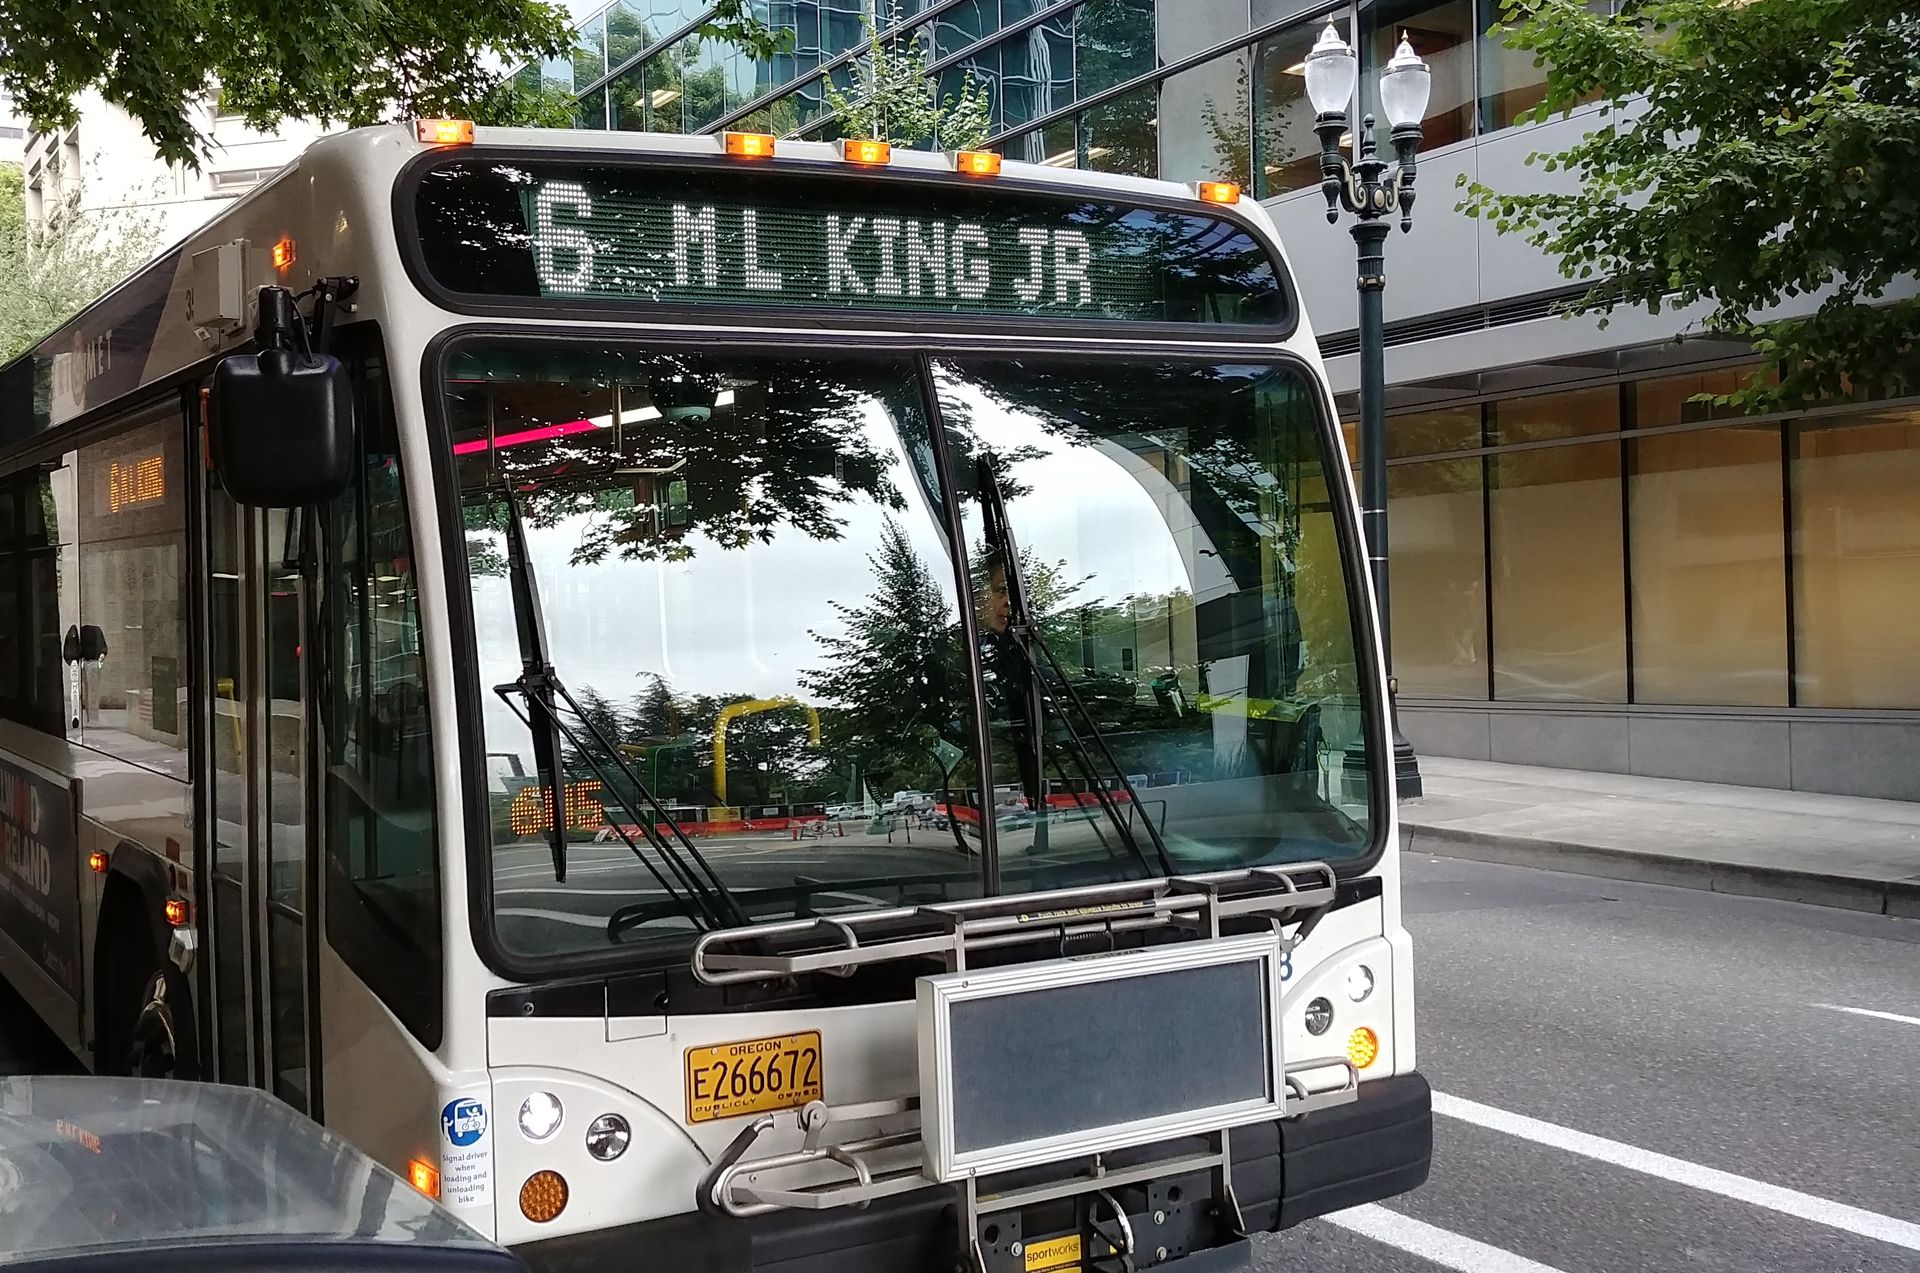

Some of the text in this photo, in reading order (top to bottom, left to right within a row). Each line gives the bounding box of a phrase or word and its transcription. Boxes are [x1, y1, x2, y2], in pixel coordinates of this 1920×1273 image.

[537, 182, 593, 293] 6
[827, 214, 990, 299] KING
[1014, 227, 1092, 303] JR
[730, 1040, 782, 1056] OREGON
[693, 1047, 818, 1102] E266672
[695, 1087, 819, 1113] PUBLICLY OWNED
[442, 1151, 488, 1164] Signal driver
[455, 1164, 476, 1172] when
[444, 1171, 487, 1183] loading and
[447, 1183, 485, 1194] unloading
[458, 1195, 475, 1204] bike
[1026, 1242, 1079, 1263] sportworks
